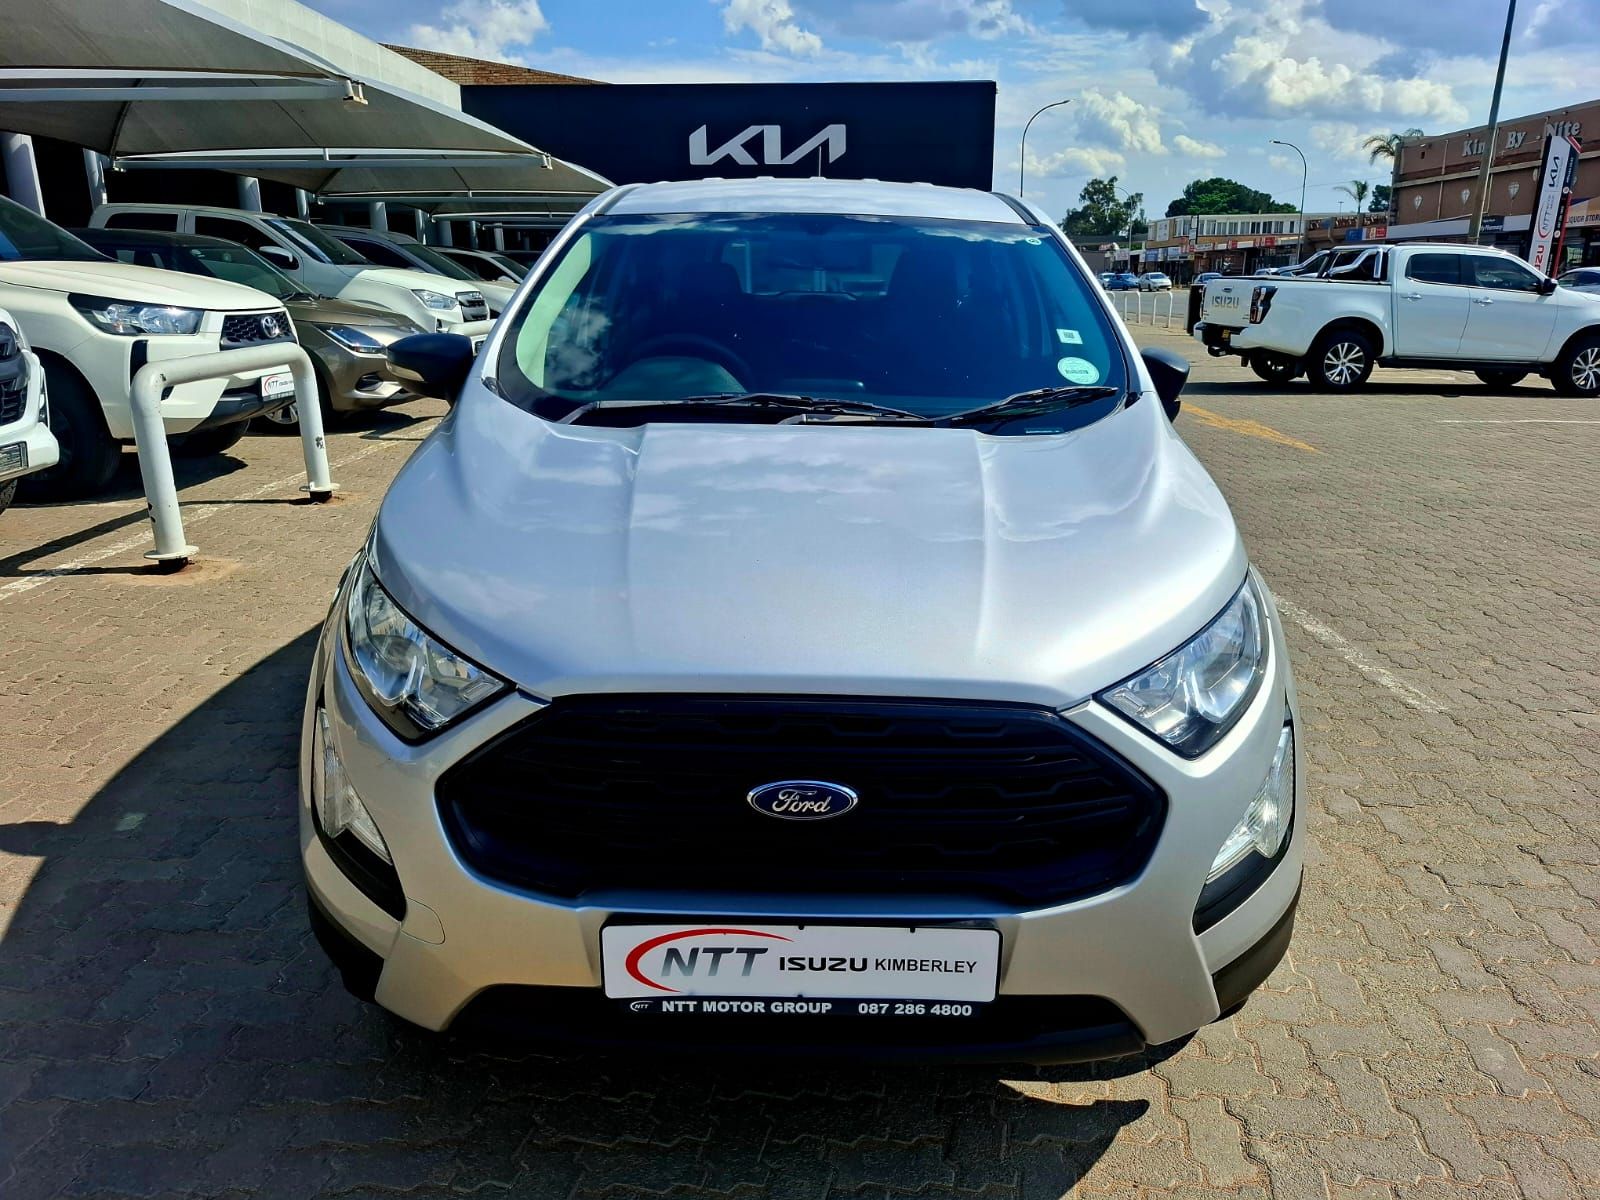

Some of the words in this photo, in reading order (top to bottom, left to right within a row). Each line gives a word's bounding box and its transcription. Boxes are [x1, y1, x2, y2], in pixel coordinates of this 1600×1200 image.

[689, 124, 846, 165] KIA
[1462, 139, 1487, 157] Kin
[1506, 131, 1526, 149] By
[1549, 156, 1560, 188] KIA
[1534, 245, 1544, 271] UZU
[1212, 296, 1239, 308] ISUZU
[772, 789, 831, 812] Ford
[661, 947, 768, 977] NTT
[779, 956, 868, 973] ISUZU
[875, 957, 978, 974] KIMBERLEY
[662, 1001, 697, 1012] NTT
[702, 1001, 765, 1013] MOTOR
[770, 1001, 832, 1014] GROUP
[858, 1003, 890, 1014] 087
[894, 1003, 926, 1015] 286
[930, 1004, 972, 1016] 4800
